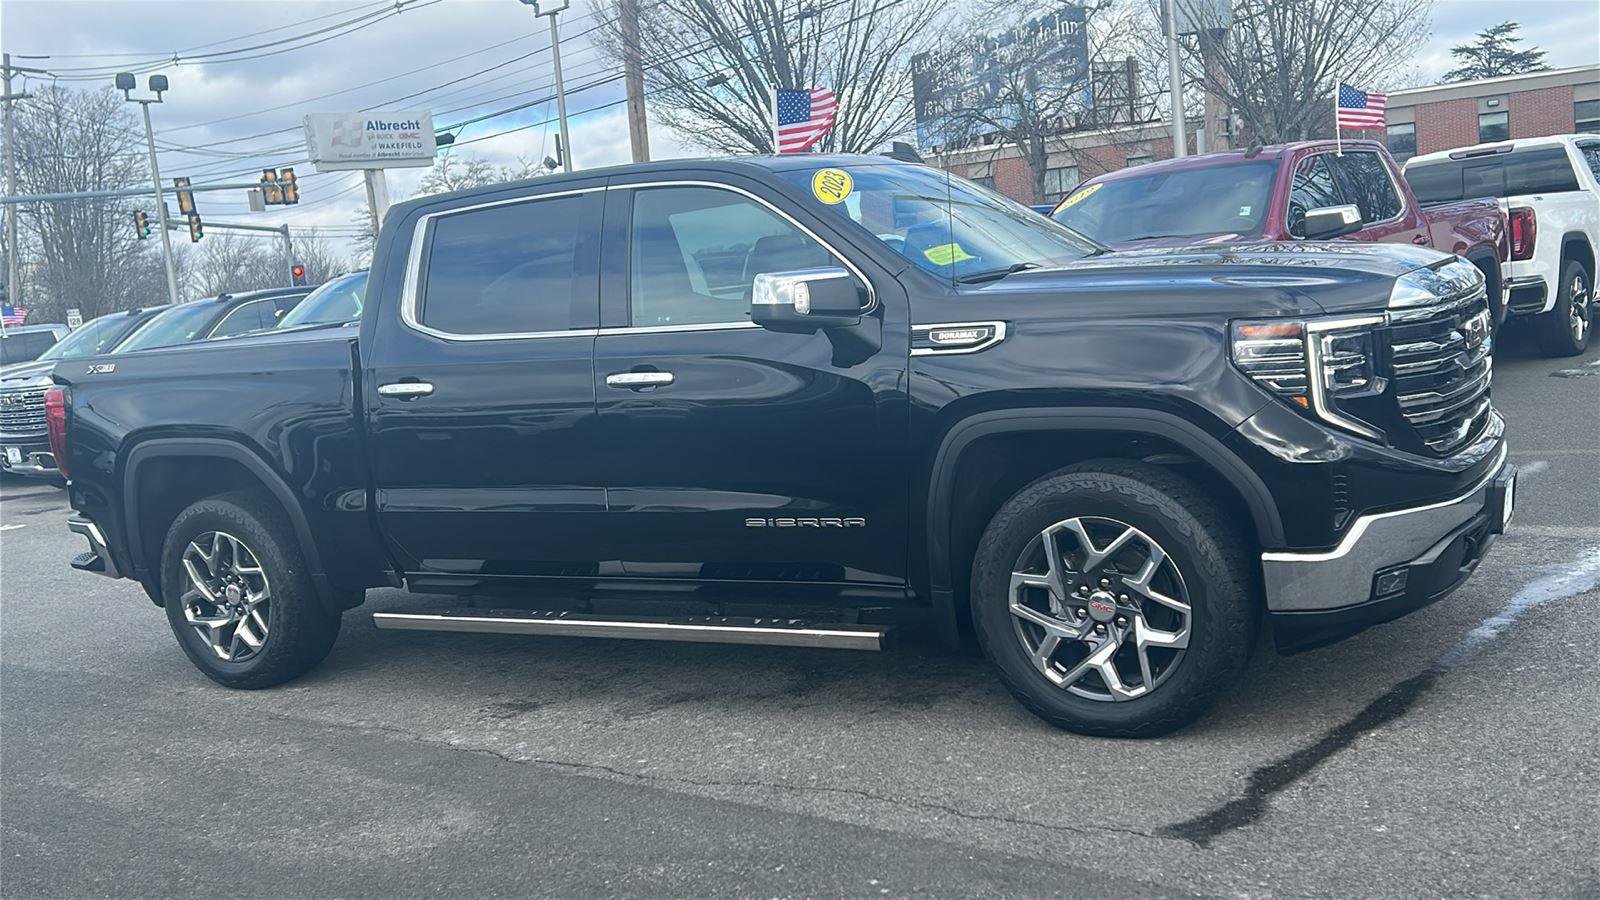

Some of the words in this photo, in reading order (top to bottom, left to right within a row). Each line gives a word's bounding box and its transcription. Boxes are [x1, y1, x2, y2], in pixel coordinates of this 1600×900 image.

[366, 120, 421, 131] Albrecht
[379, 142, 422, 150] WAKEFIELD
[820, 171, 845, 198] 2023
[69, 317, 81, 326] 128
[938, 330, 978, 340] DURAMAX
[745, 517, 866, 528] SIERRA
[1088, 600, 1115, 613] GMC
